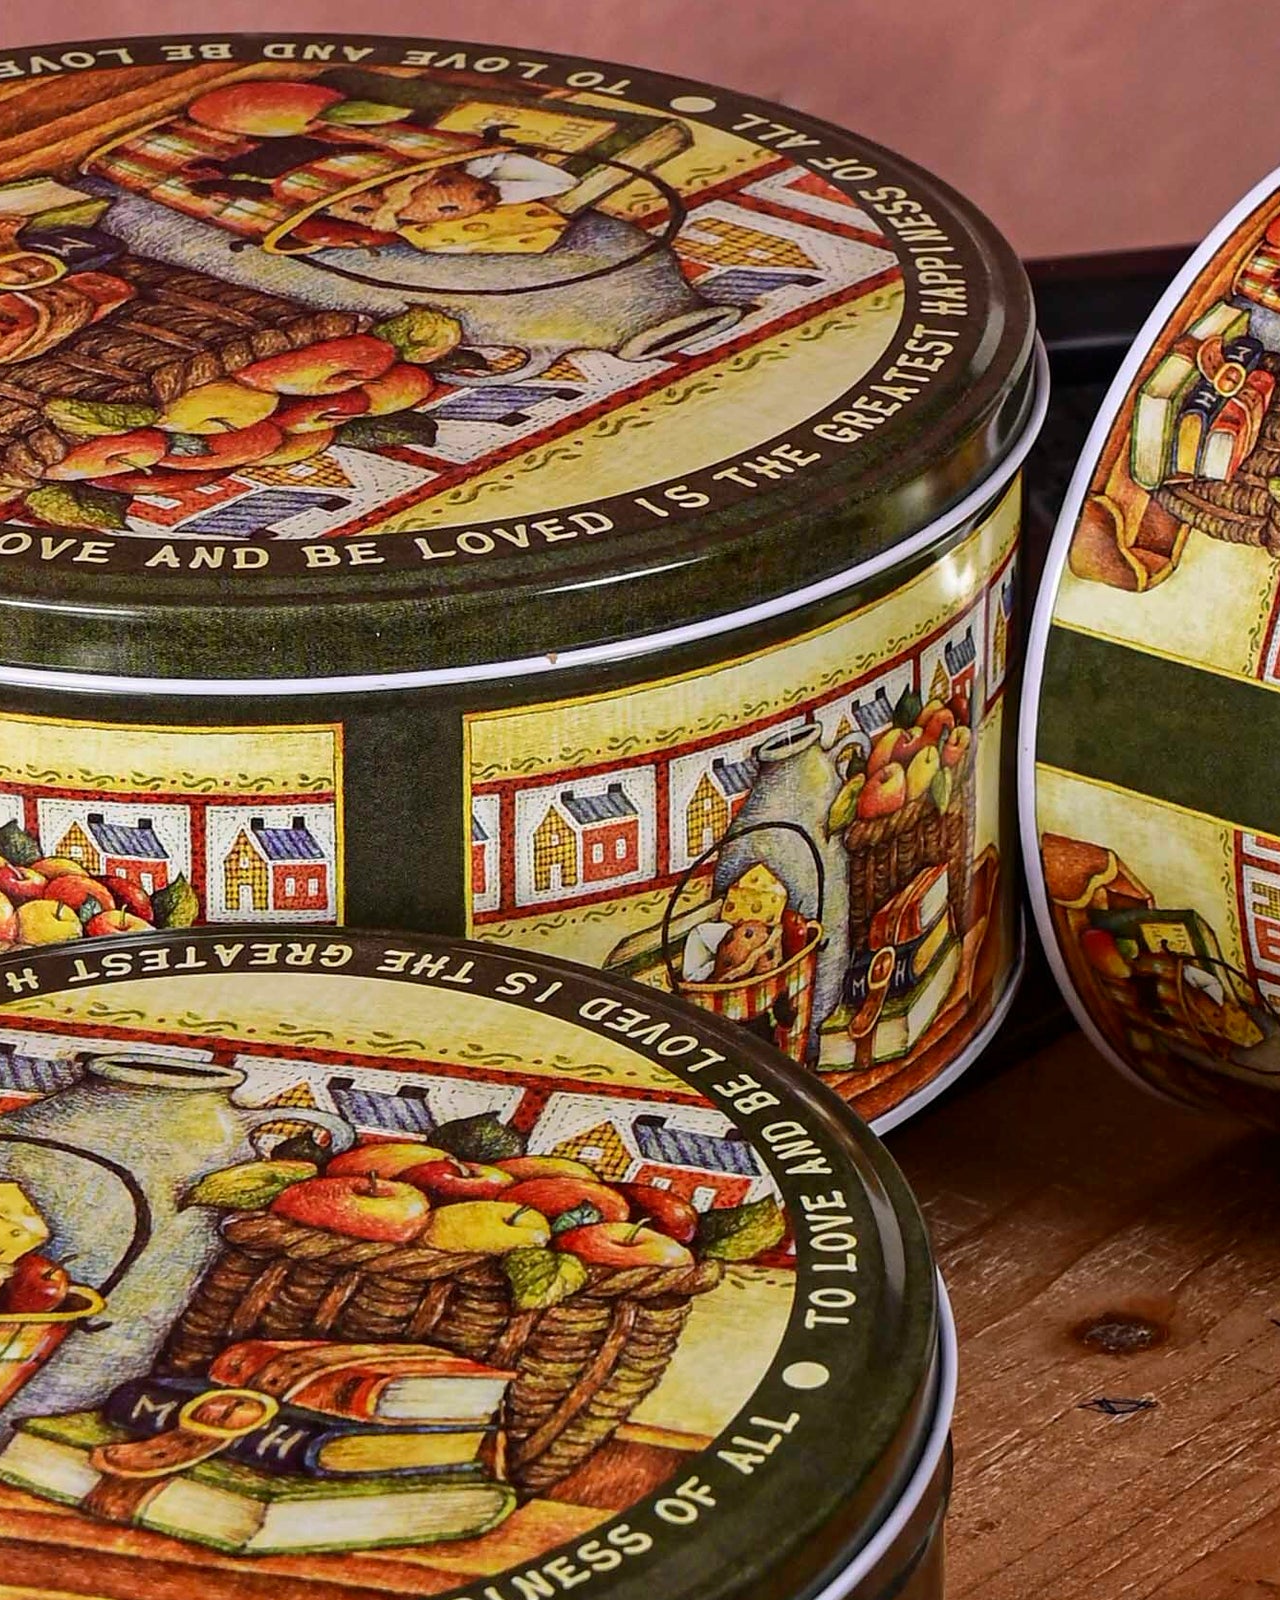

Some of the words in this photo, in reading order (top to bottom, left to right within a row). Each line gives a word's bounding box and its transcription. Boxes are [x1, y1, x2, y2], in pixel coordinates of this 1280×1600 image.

[159, 42, 233, 61] BE
[262, 42, 375, 62] AND
[400, 49, 549, 79] LOVE
[565, 70, 631, 95] TO
[730, 112, 821, 149] ALL
[805, 156, 878, 181] OF
[856, 185, 968, 316] HAPPINESS
[811, 322, 960, 443] GREATEST
[711, 442, 822, 488] THE
[632, 483, 710, 517] IS
[299, 541, 386, 568] BE
[412, 510, 614, 560] LOVED
[143, 543, 269, 570] AND
[67, 941, 353, 983] GREATEST
[374, 948, 475, 984] THE
[493, 971, 563, 1003] IS
[577, 996, 727, 1073] LOVED
[711, 1072, 781, 1115] BE
[760, 1120, 833, 1175] AND
[798, 1189, 858, 1273] LOVE
[803, 1286, 857, 1330] TO
[653, 1474, 716, 1525] OF
[715, 1411, 801, 1475] ALL
